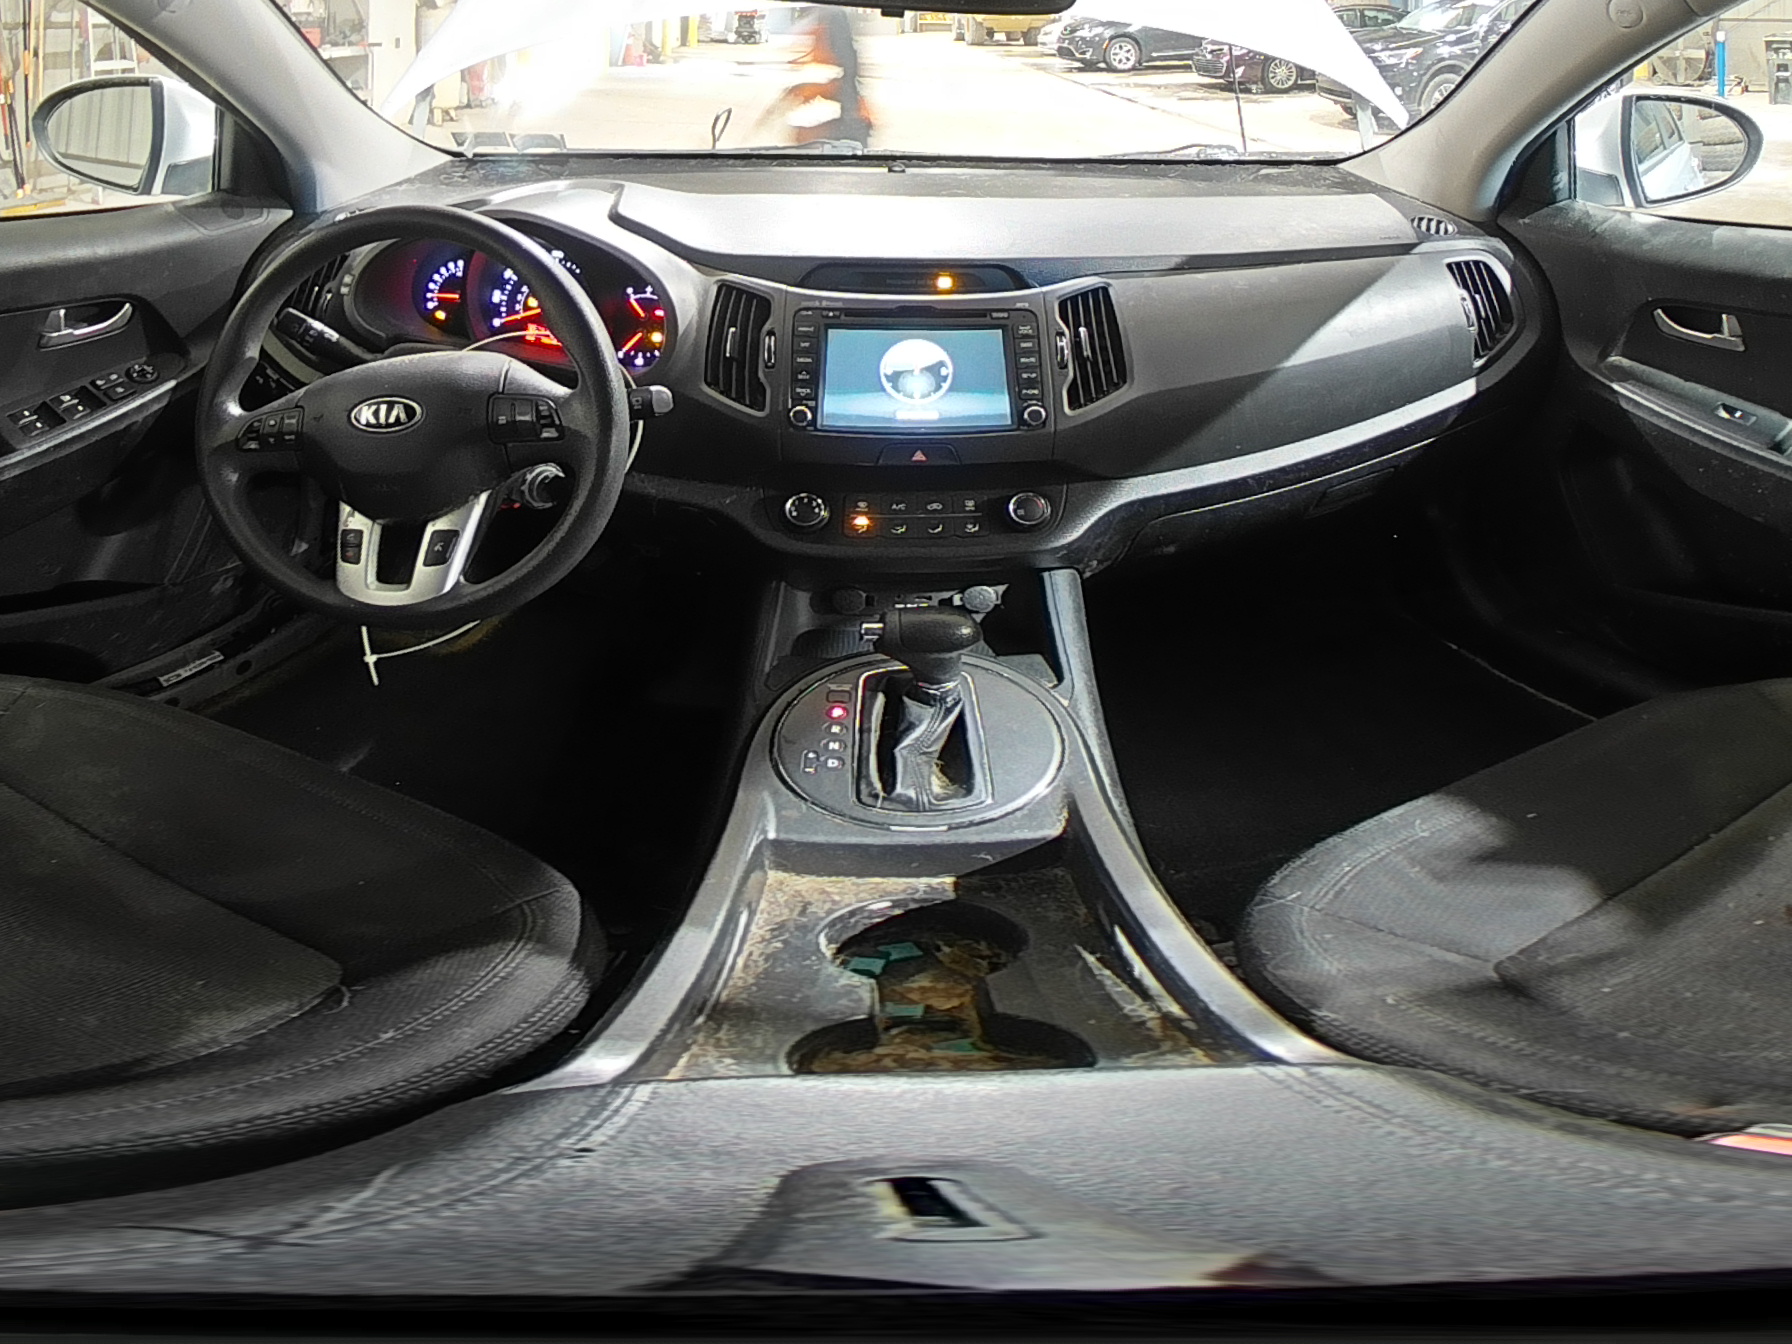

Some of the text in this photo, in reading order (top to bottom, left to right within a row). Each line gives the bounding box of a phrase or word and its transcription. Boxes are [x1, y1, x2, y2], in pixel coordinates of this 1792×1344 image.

[360, 405, 410, 426] KIA
[891, 502, 906, 510] A/C
[828, 742, 839, 750] N
[826, 759, 839, 767] D
